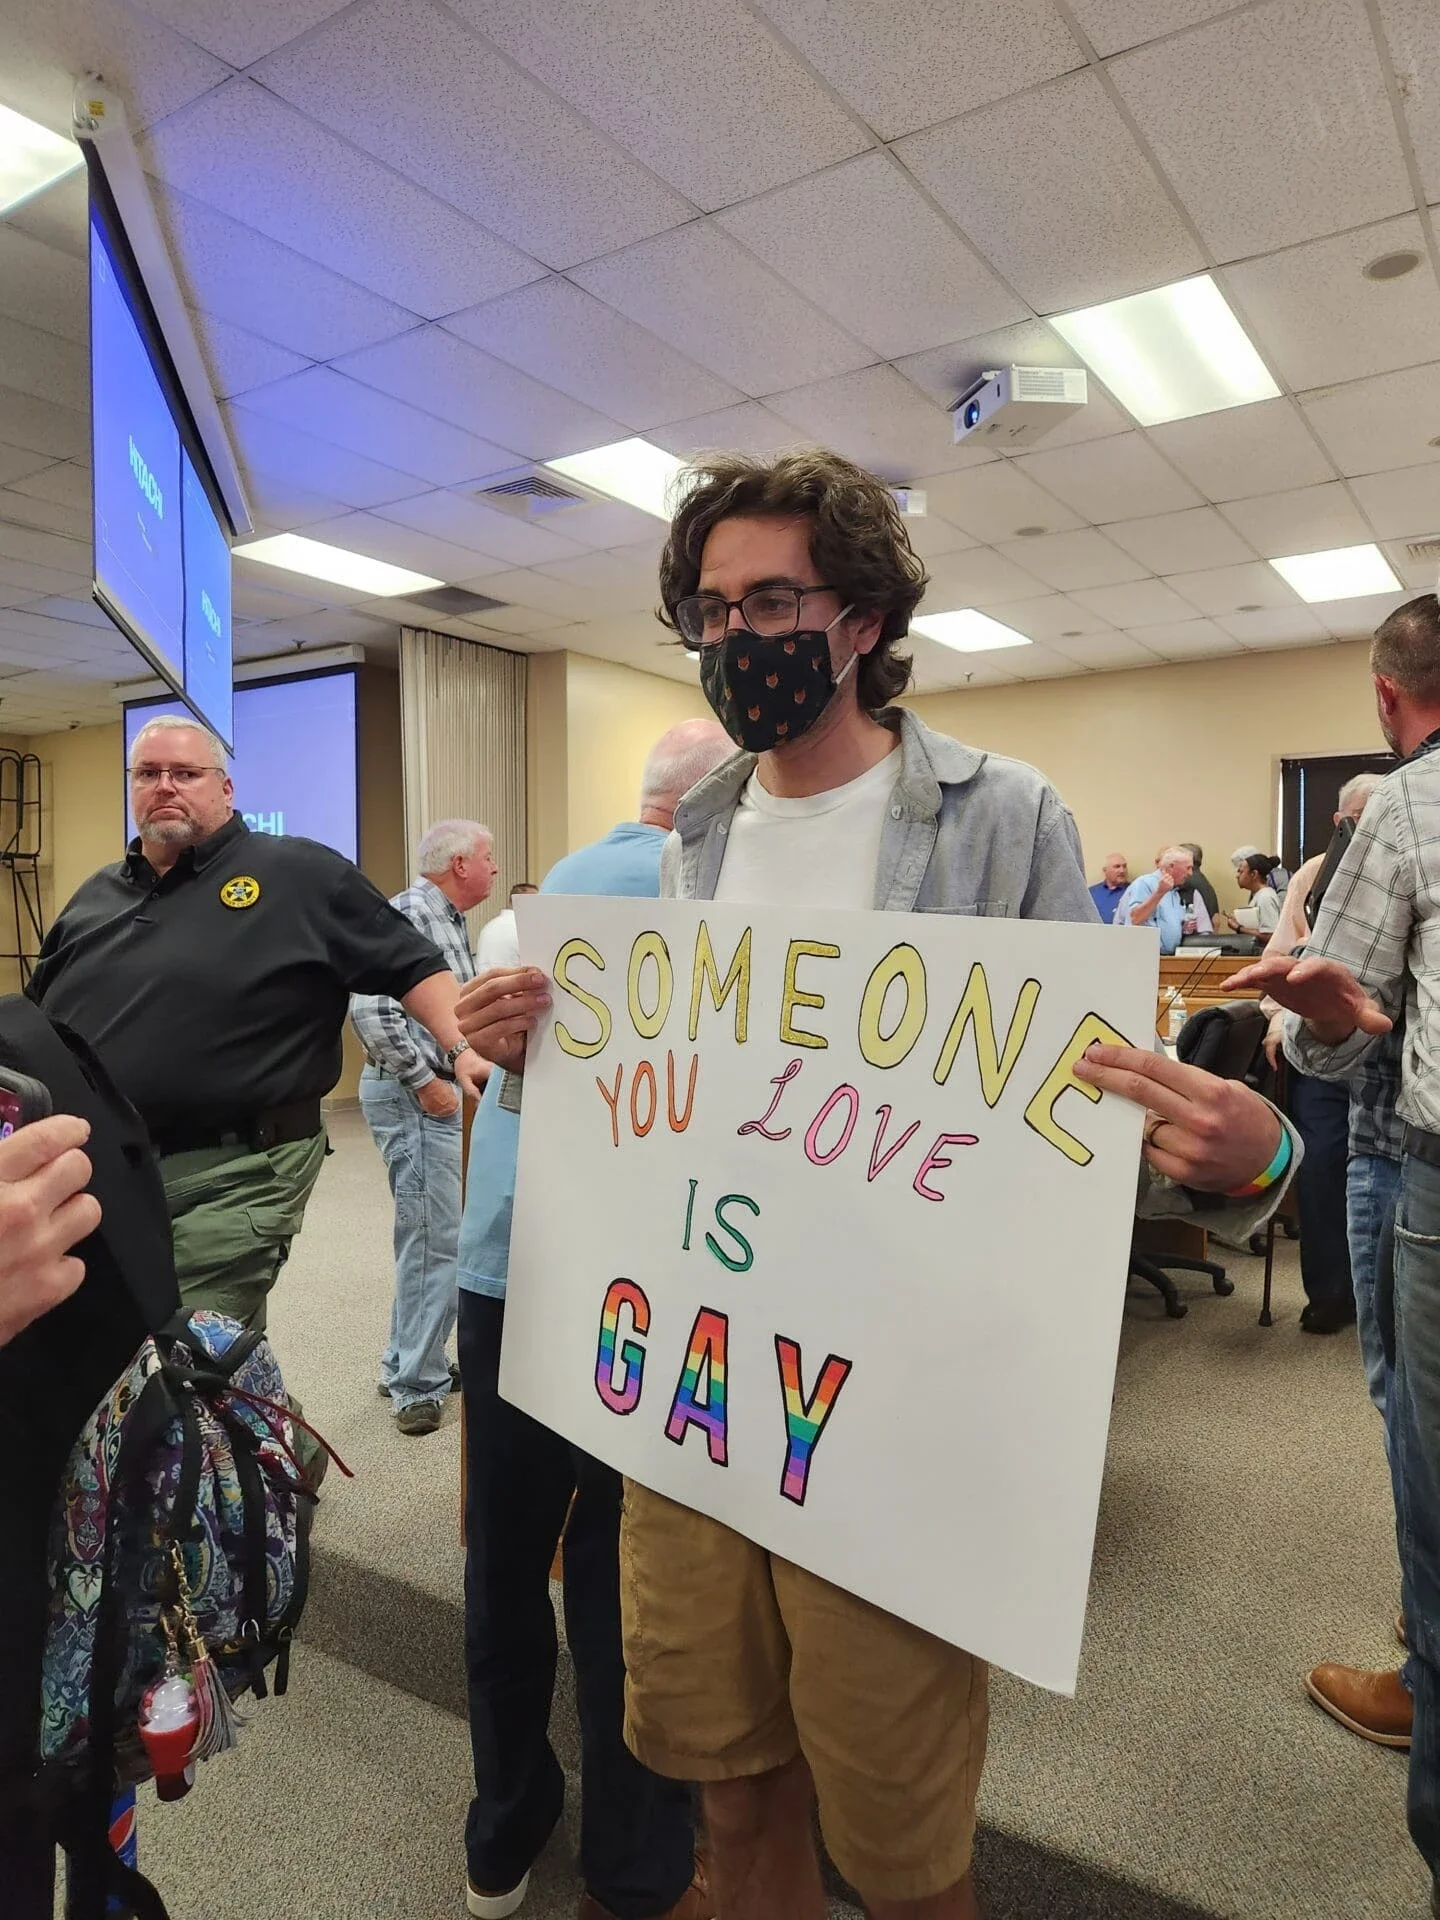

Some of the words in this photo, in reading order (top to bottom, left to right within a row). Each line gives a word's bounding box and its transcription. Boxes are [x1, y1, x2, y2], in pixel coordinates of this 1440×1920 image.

[129, 434, 163, 520] HITACHI
[553, 919, 1138, 1167] SOMEONE
[595, 1049, 698, 1147] YOU
[737, 1058, 979, 1202] LOVE
[682, 1178, 760, 1273] IS
[594, 1277, 853, 1507] GAY
